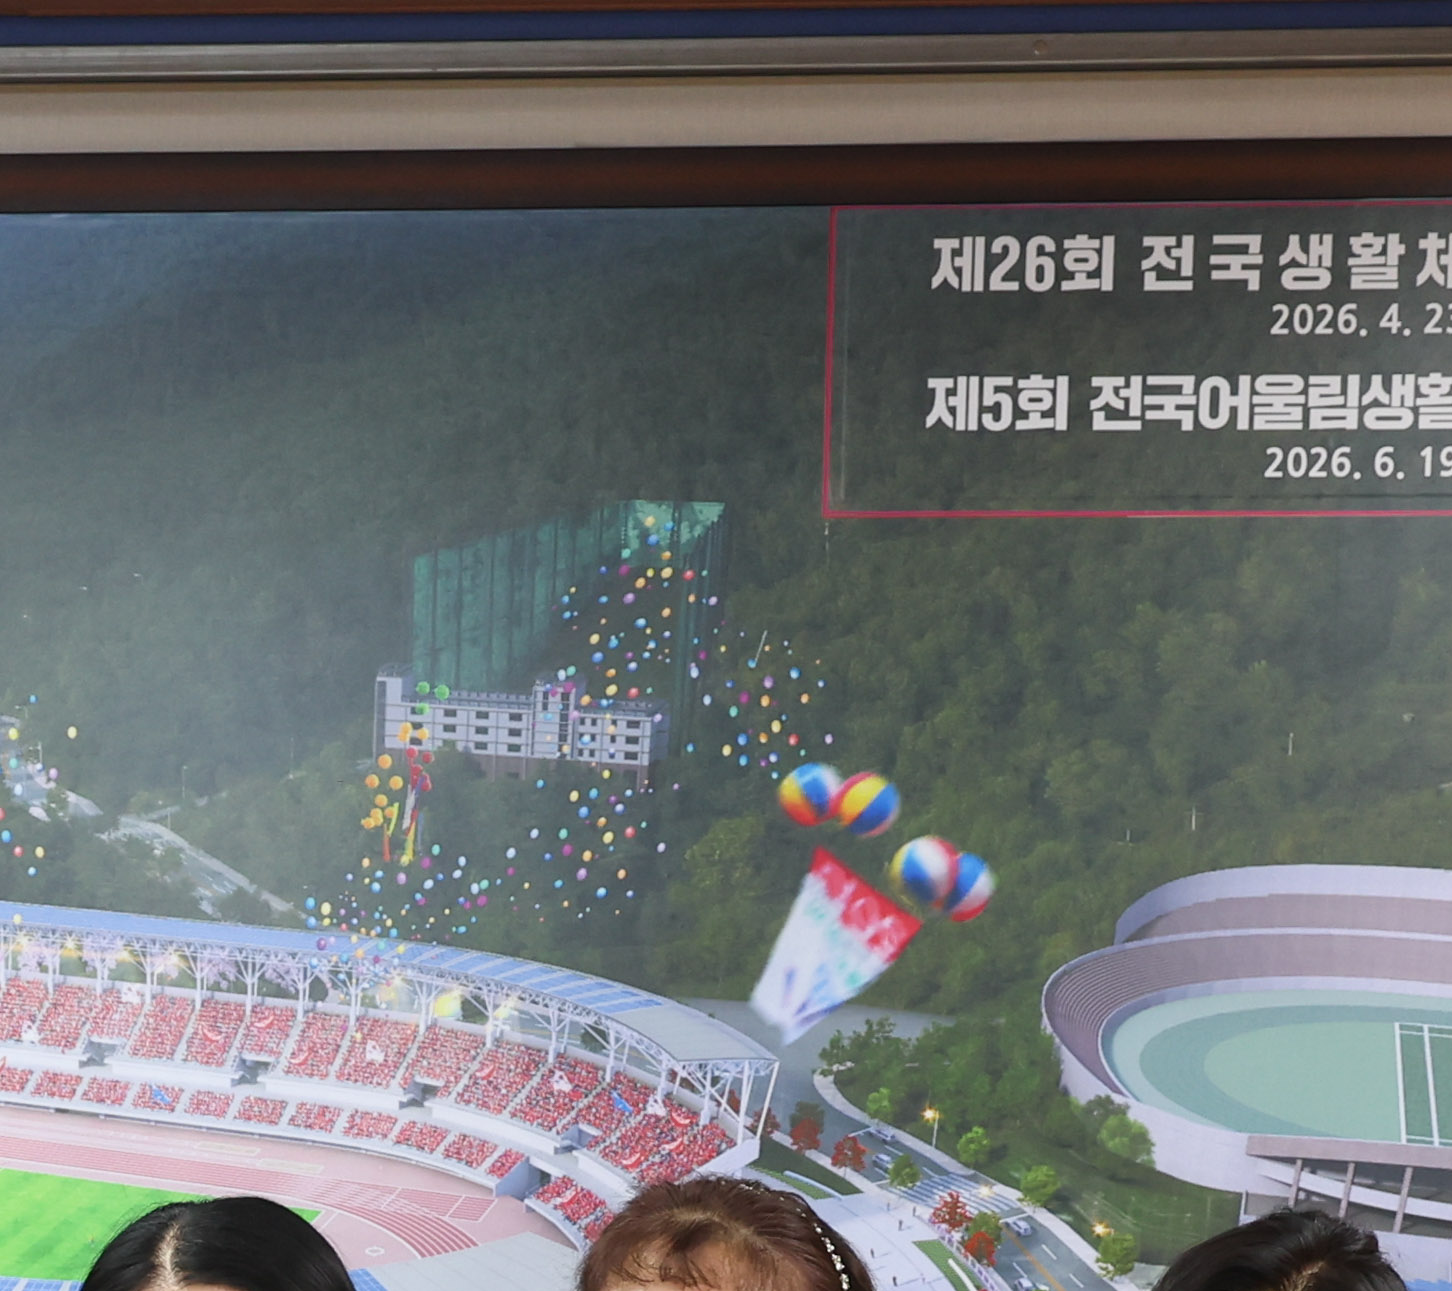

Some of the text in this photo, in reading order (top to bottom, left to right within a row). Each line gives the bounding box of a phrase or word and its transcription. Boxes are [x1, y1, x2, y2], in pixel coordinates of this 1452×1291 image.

[931, 233, 1115, 294] 제26회
[1270, 303, 1368, 336] 2026.
[1379, 303, 1413, 336] 4.
[926, 376, 1068, 433] 제5회
[1264, 446, 1362, 479] 2026.
[1373, 446, 1406, 479] 6.
